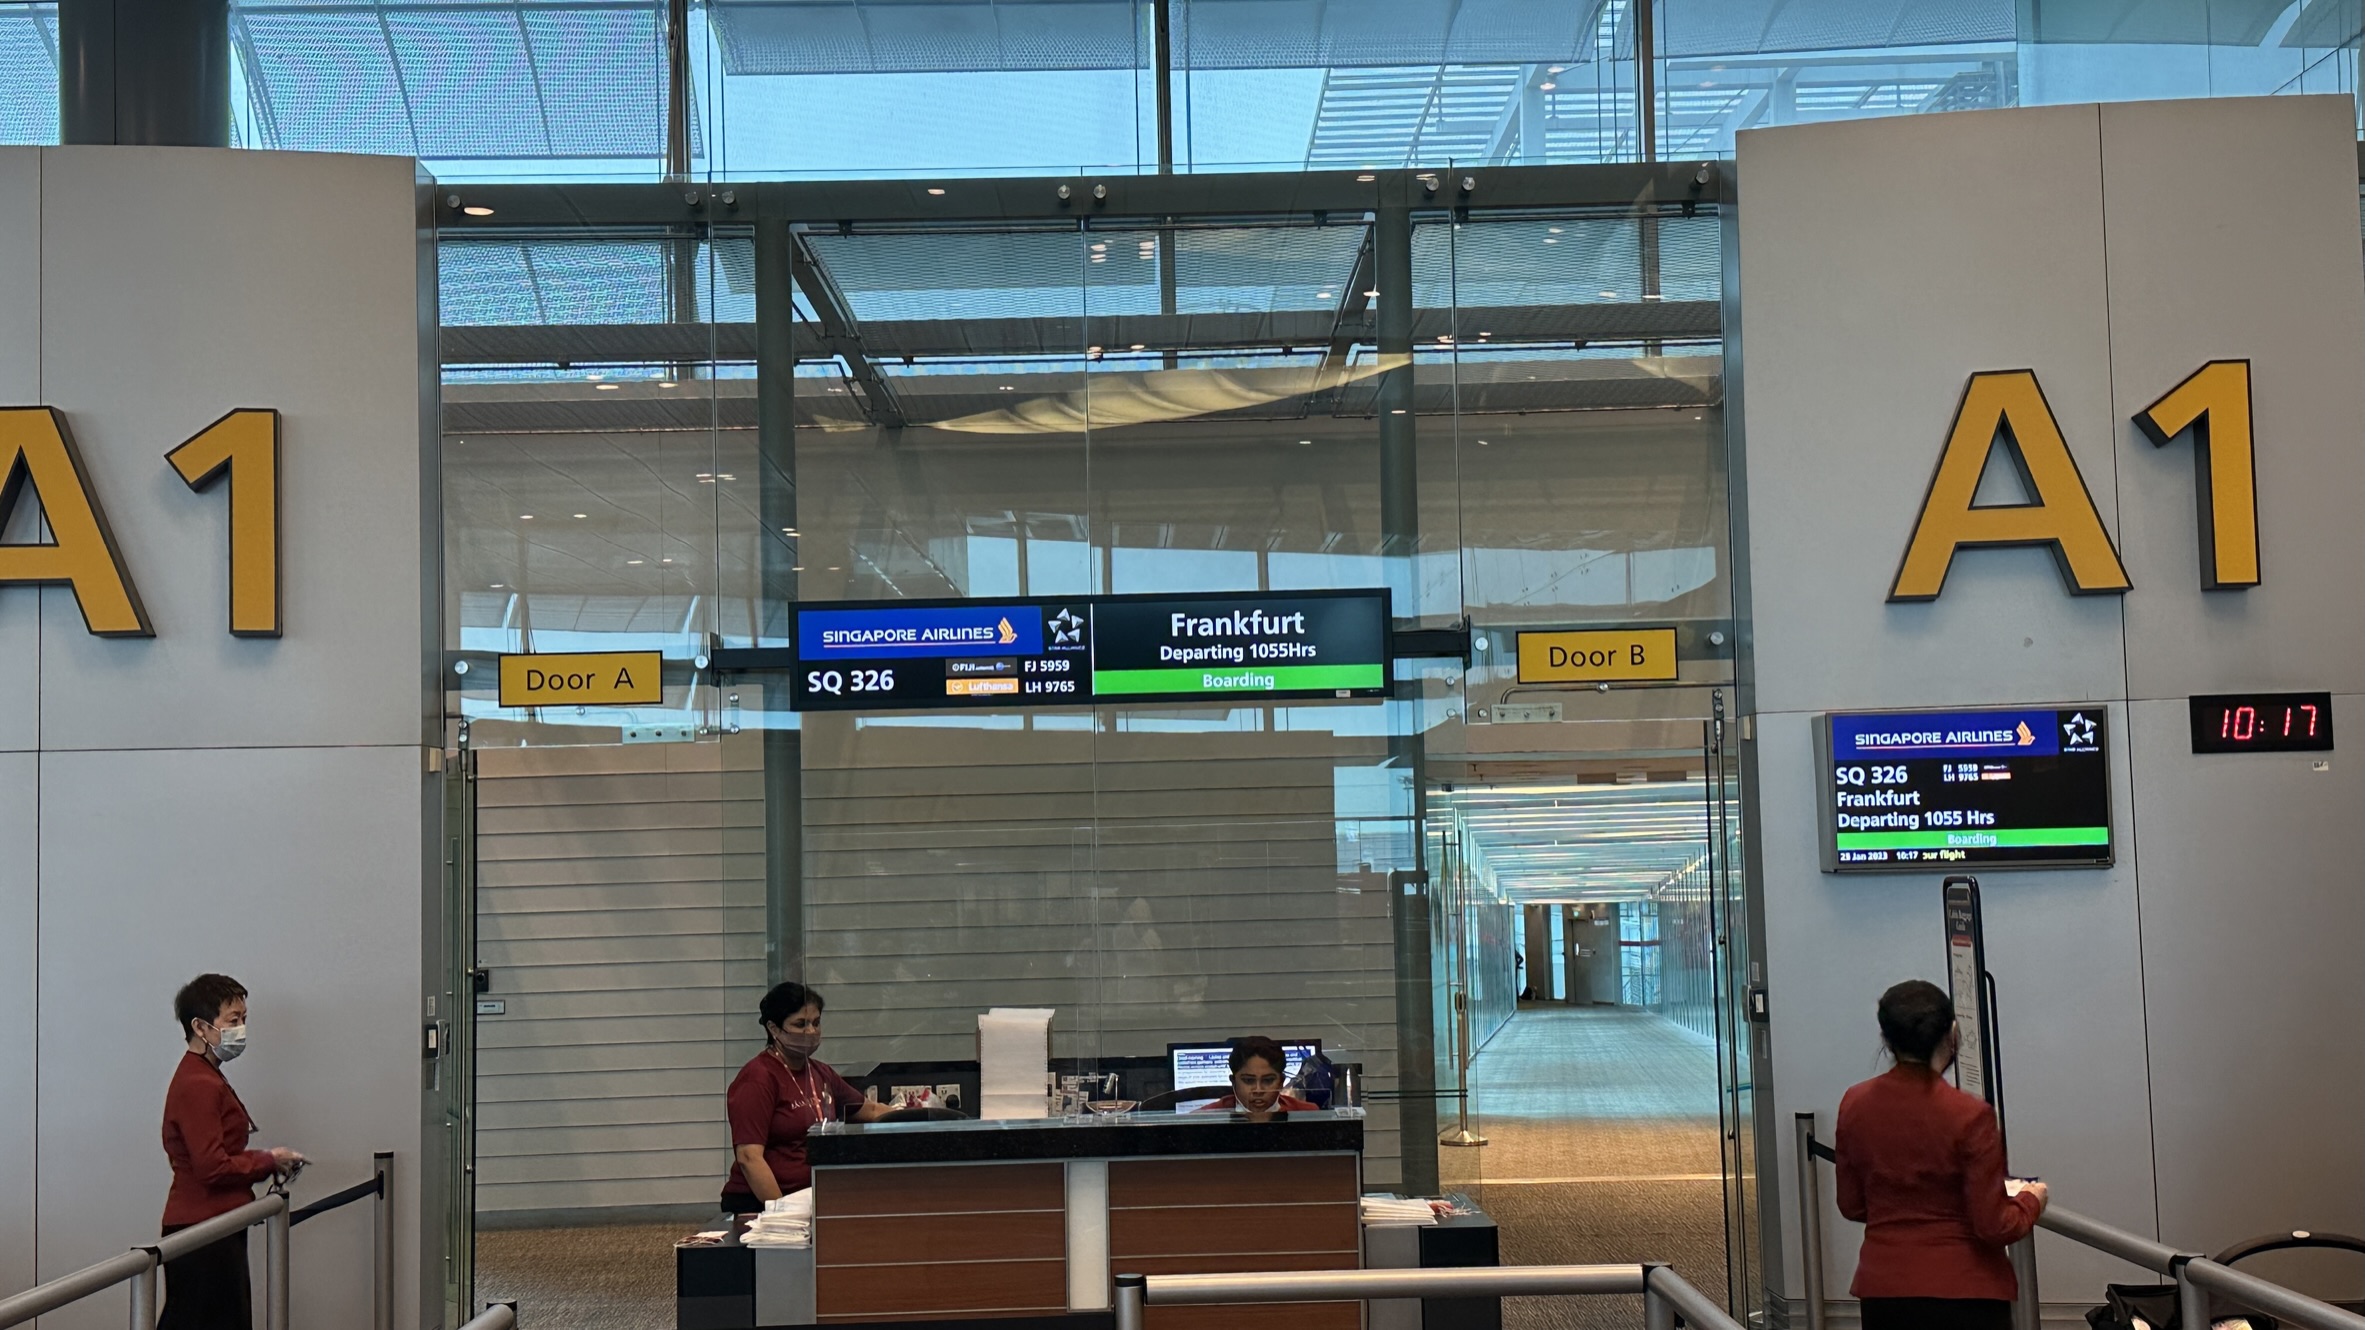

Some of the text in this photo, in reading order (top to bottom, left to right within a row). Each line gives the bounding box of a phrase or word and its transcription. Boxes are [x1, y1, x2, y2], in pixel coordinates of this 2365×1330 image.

[1885, 358, 2262, 603] A1
[0, 405, 283, 638] A1
[1170, 609, 1305, 638] Frankfurt
[823, 626, 994, 645] SINGAPORE AIRLINES
[1159, 641, 1317, 663] Departing 1055Hrs
[1549, 644, 1645, 667] Door B
[1024, 659, 1070, 672] FJ 5959
[526, 667, 634, 691] Door A
[807, 669, 895, 696] SQ 326
[968, 681, 1013, 692] Lufthansa
[1025, 680, 1076, 693] LH 9765
[1202, 670, 1275, 690] Boarding
[1855, 729, 2014, 746] SINGAPORE AIRLINES
[1836, 765, 1908, 787] SQ 326
[1837, 789, 1921, 807] Frankfurt
[1837, 809, 1995, 830] Departing 1055 Hrs
[1947, 833, 1997, 846] Boarding
[1852, 852, 1867, 861] Jan
[1896, 851, 1919, 860] 10:17
[1940, 850, 1966, 862] flight
